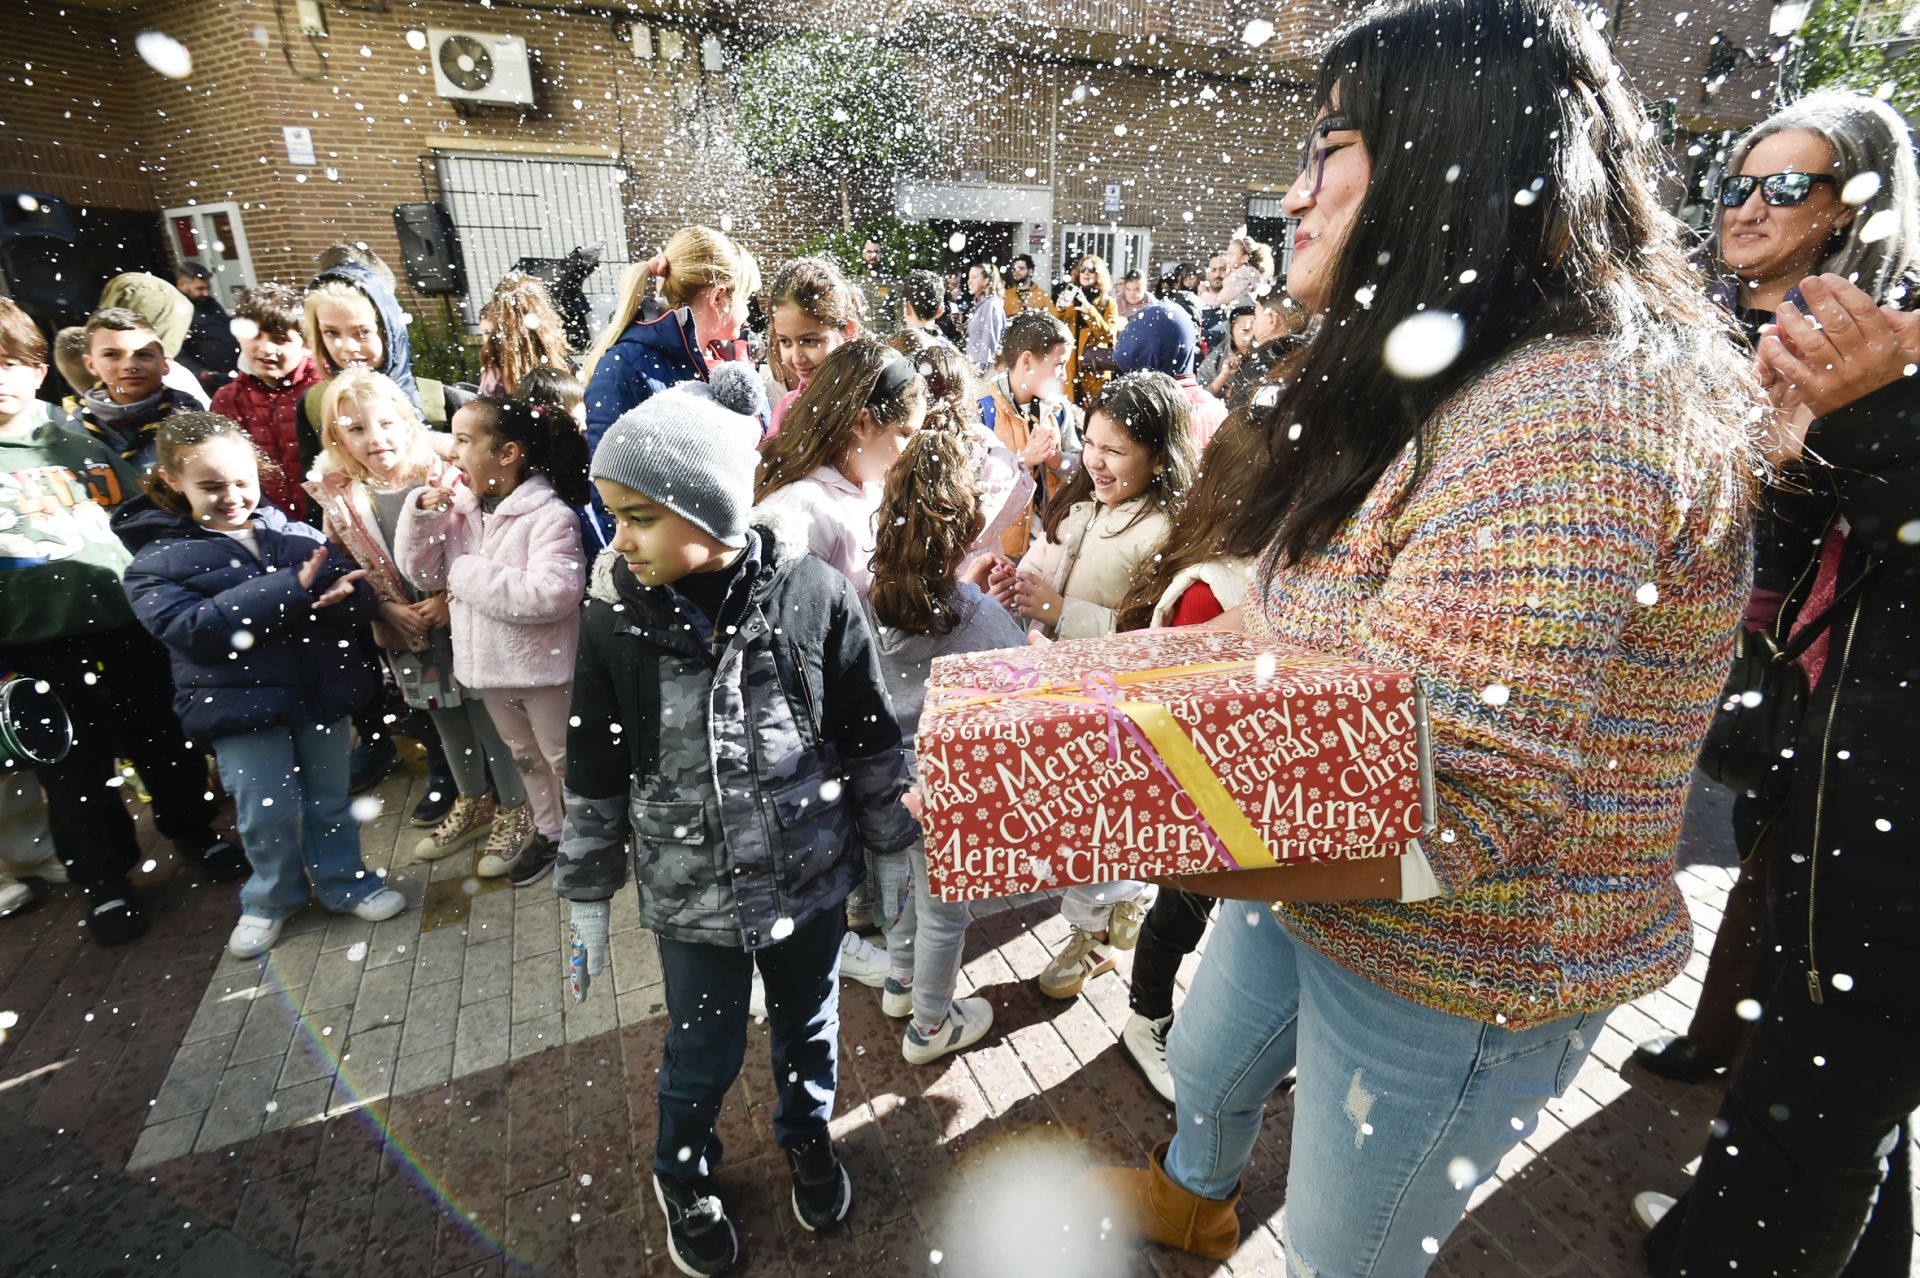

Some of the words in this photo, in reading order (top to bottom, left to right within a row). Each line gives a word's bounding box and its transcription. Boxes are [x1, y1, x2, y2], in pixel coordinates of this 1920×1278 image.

[995, 721, 1122, 806] Merry
[1000, 749, 1149, 844] Christmas
[1340, 732, 1418, 797] Chris
[1088, 803, 1216, 873] Merry
[1258, 779, 1390, 847] Merry
